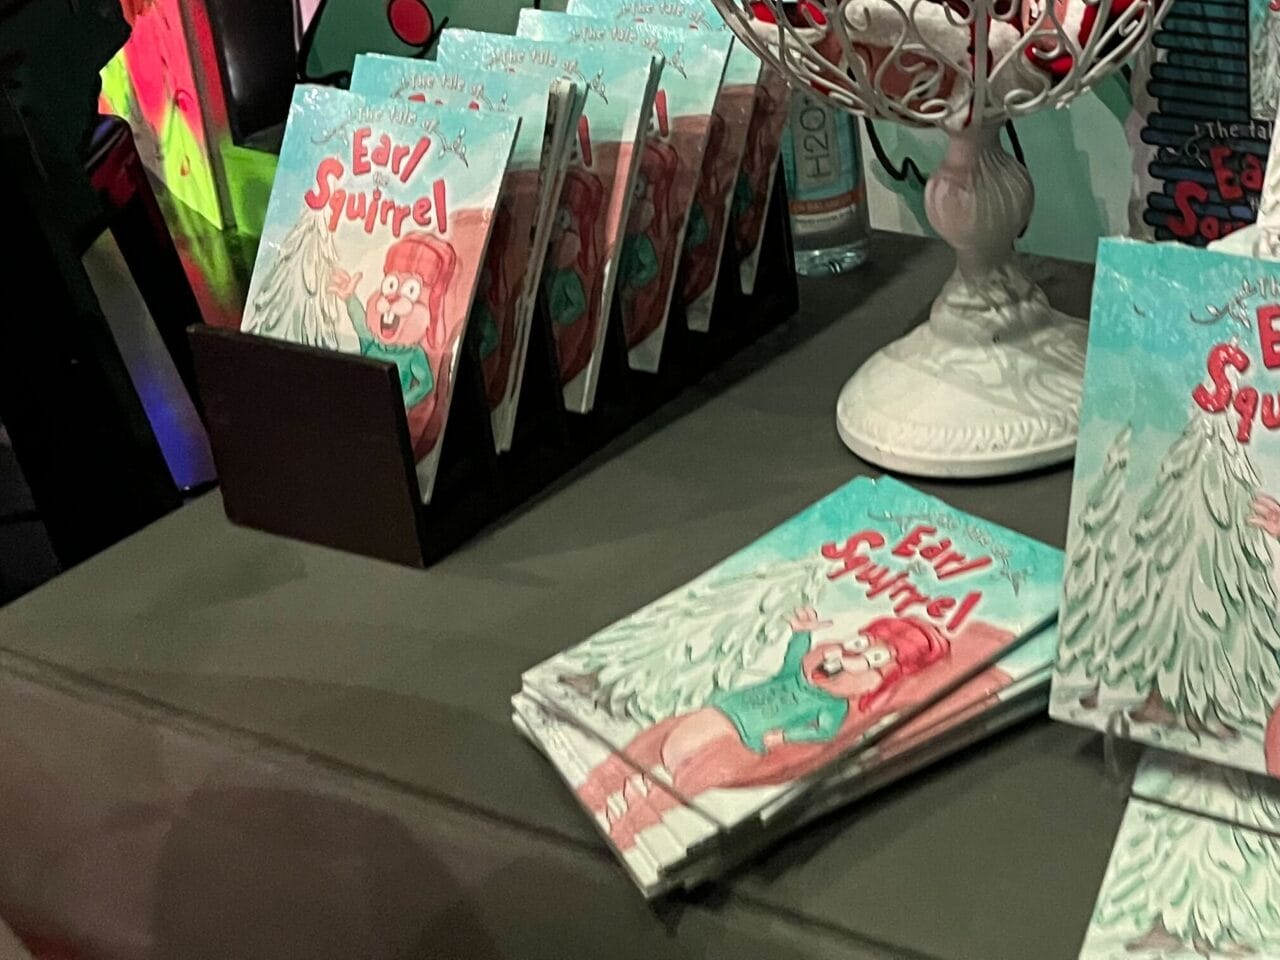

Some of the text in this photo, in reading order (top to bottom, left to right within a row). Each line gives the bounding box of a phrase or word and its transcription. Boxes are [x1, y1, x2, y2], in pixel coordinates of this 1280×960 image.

[353, 127, 431, 183] Earl
[1205, 120, 1273, 140] The tal
[304, 157, 446, 238] Squirrel
[891, 525, 993, 580] Earl
[821, 530, 982, 632] Squirrel
